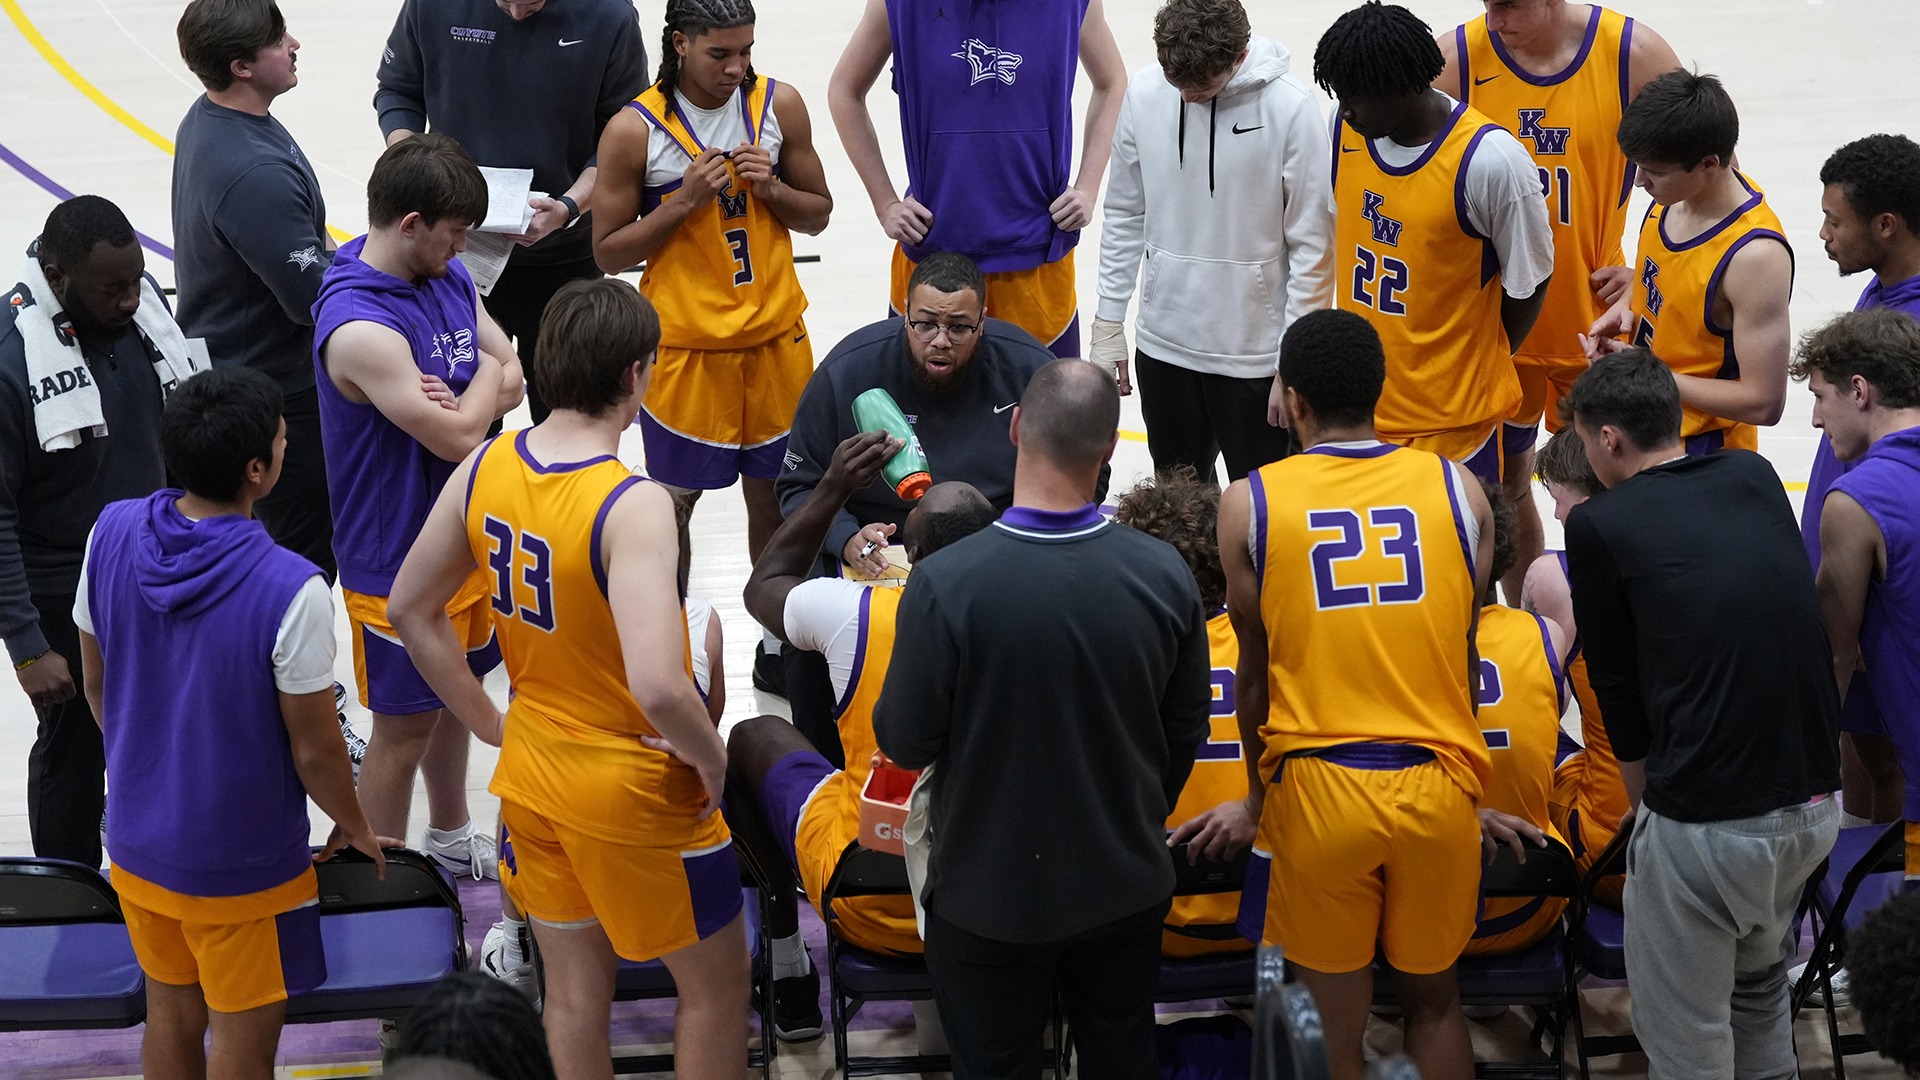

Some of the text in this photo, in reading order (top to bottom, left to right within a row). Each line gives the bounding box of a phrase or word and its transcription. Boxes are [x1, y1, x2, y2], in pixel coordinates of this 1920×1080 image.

[450, 26, 496, 39] COYOTE
[1518, 108, 1570, 155] KW
[1362, 189, 1402, 247] KW
[724, 227, 754, 287] 3
[1352, 243, 1409, 316] 22
[483, 512, 557, 634] 33
[1306, 505, 1426, 611] 23
